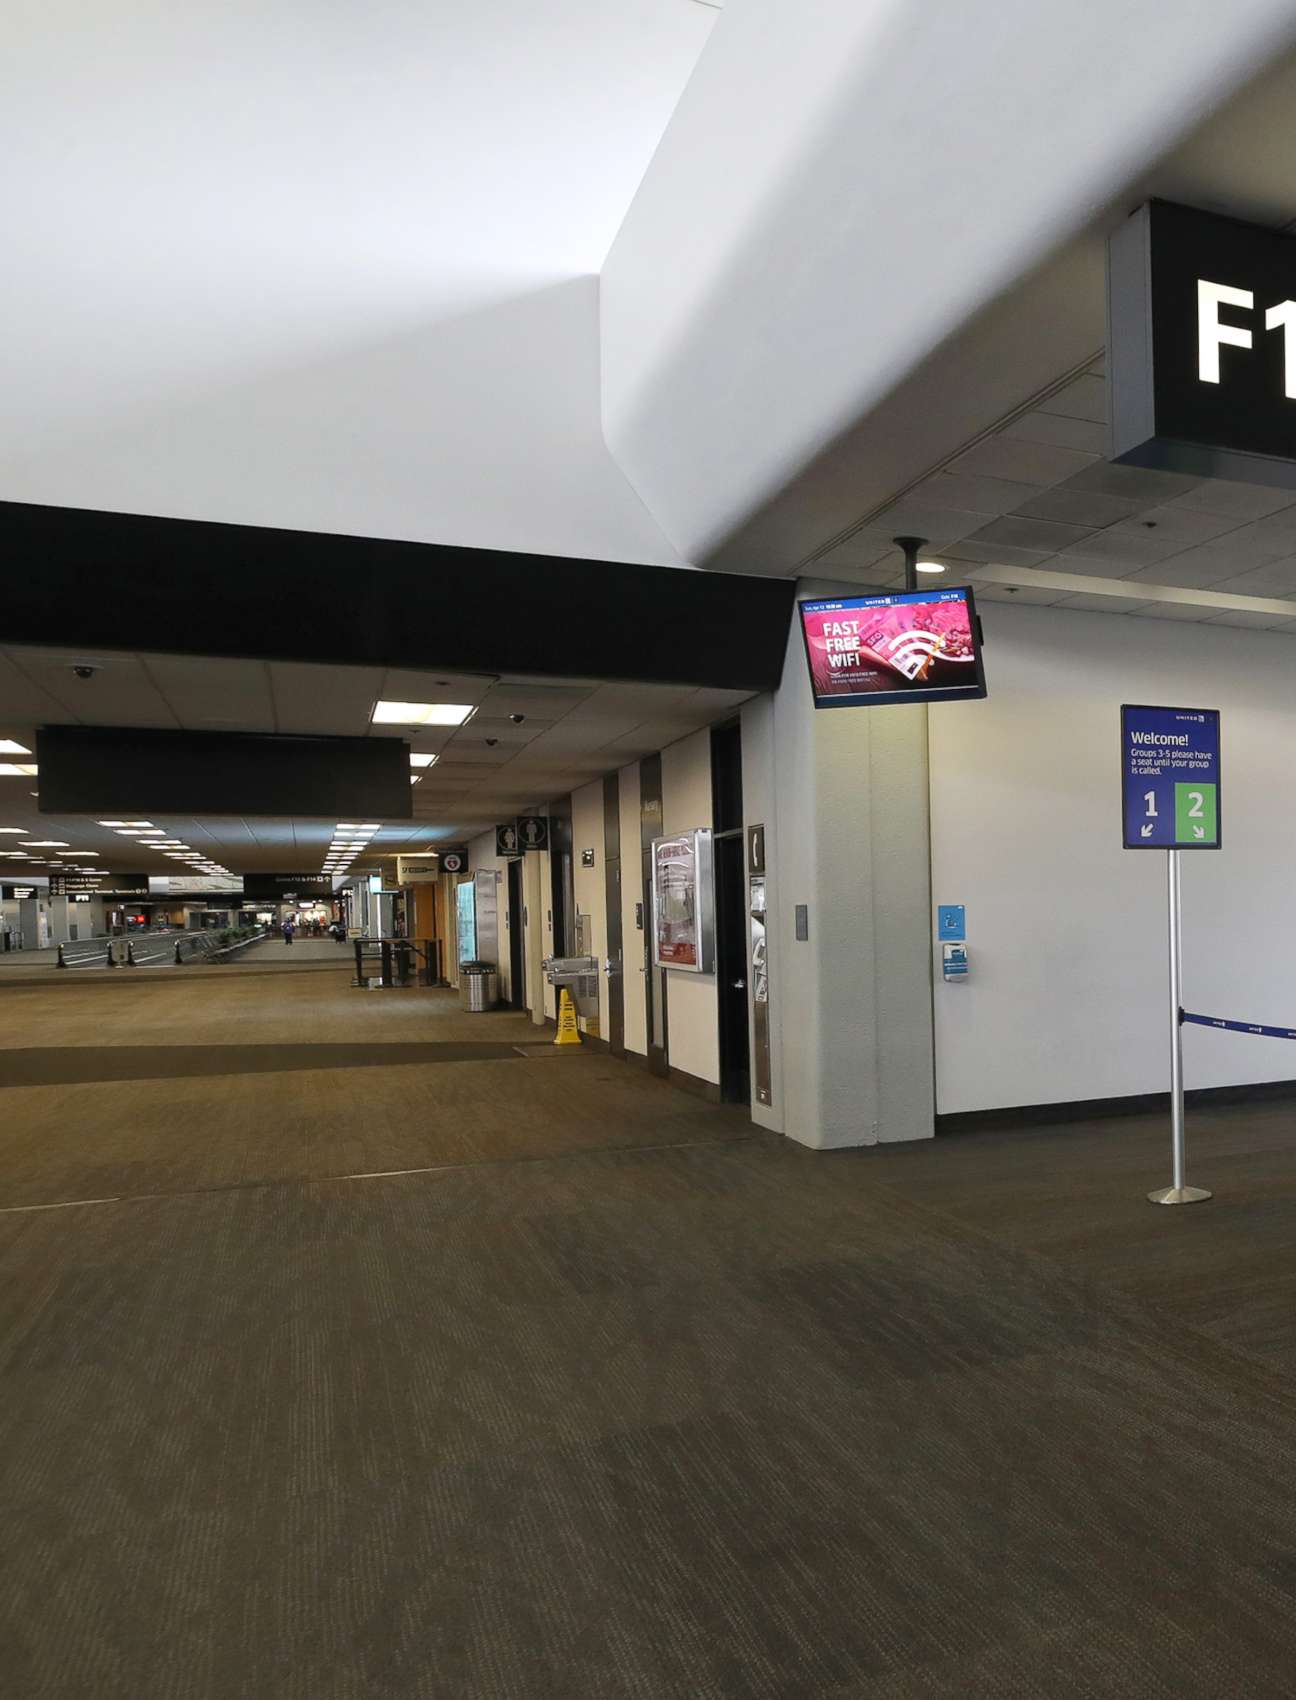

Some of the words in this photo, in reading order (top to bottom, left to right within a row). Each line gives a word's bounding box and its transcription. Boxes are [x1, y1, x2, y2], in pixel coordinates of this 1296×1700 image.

[823, 620, 860, 637] FAST
[825, 636, 861, 653] FREE
[827, 652, 861, 668] WIFI
[1131, 731, 1189, 746] Welcome!
[1131, 748, 1157, 758] Groups
[1157, 749, 1171, 758] 3-5
[1171, 750, 1194, 759] please
[1194, 751, 1212, 760] have
[1131, 766, 1138, 775] is
[1139, 767, 1162, 775] called.
[1153, 759, 1170, 767] until
[1171, 760, 1188, 768] your
[1188, 761, 1210, 769] group
[1143, 790, 1159, 817] 1
[1187, 791, 1205, 818] 2
